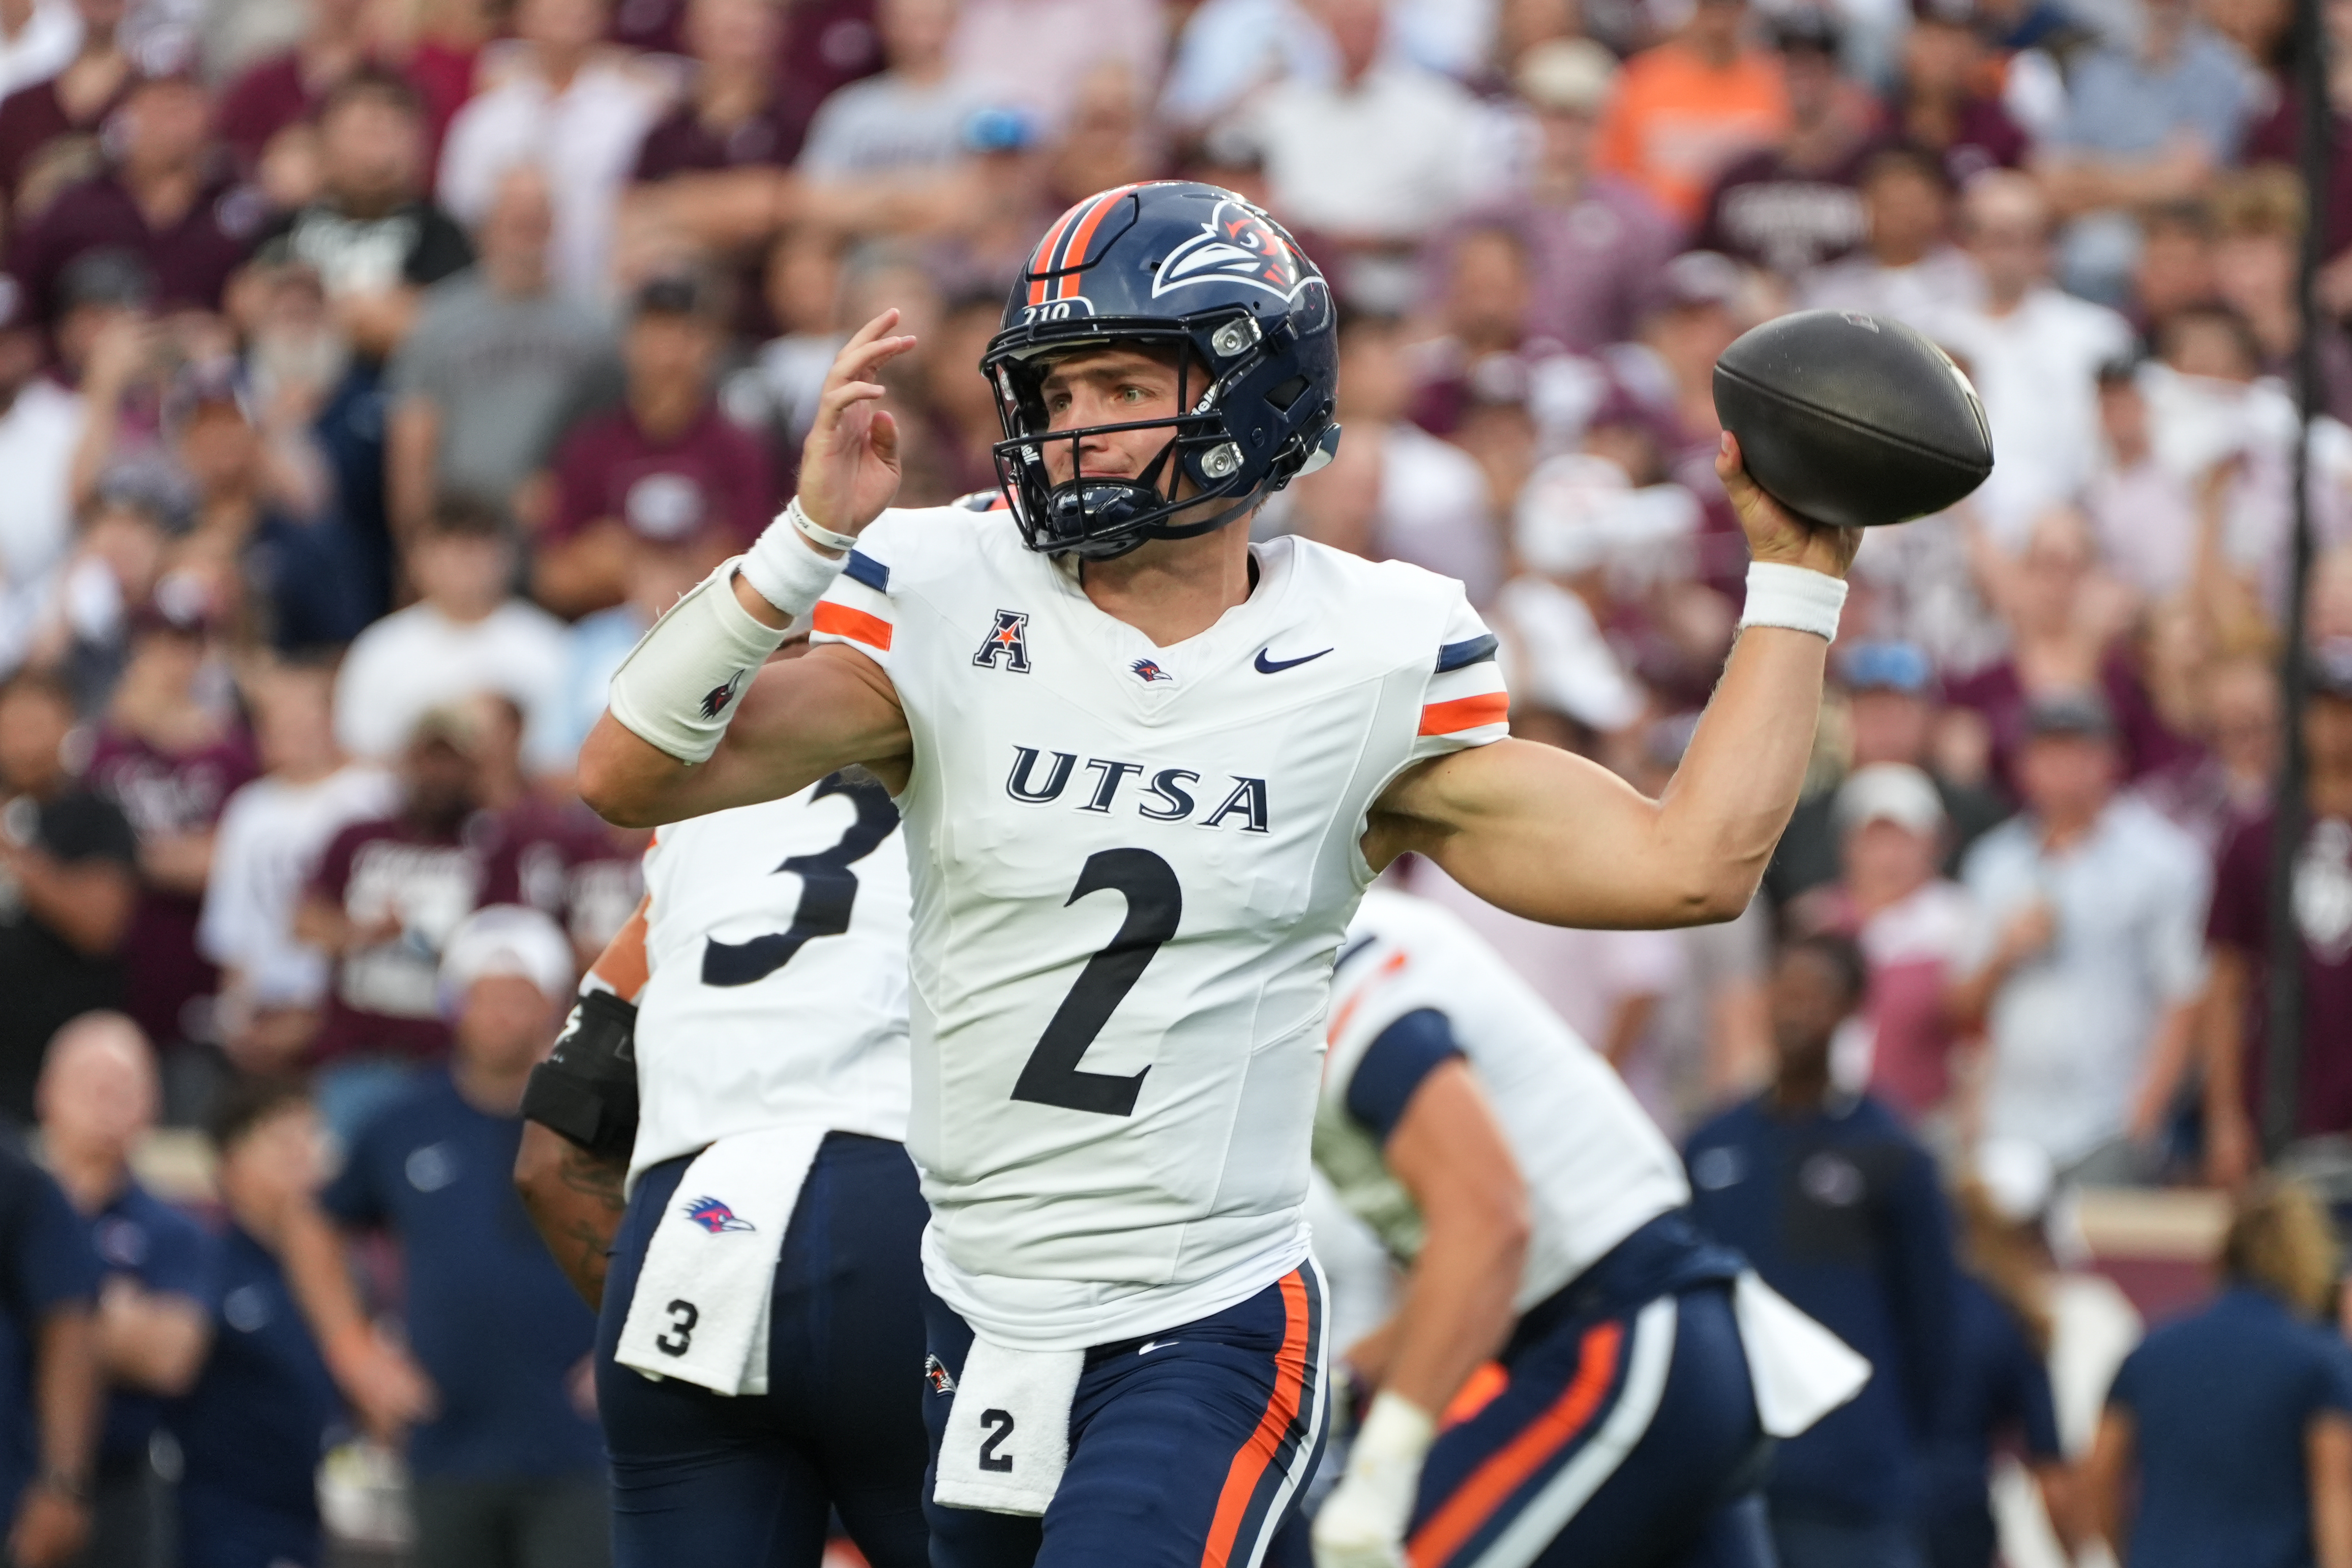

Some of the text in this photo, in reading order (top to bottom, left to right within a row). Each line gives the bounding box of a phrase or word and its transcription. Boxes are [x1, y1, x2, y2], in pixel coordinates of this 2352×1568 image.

[1006, 744, 1270, 833] UTSA
[701, 766, 901, 986] 3
[1010, 848, 1182, 1117] 2
[656, 1299, 698, 1358] 3
[979, 1409, 1014, 1473] 2
